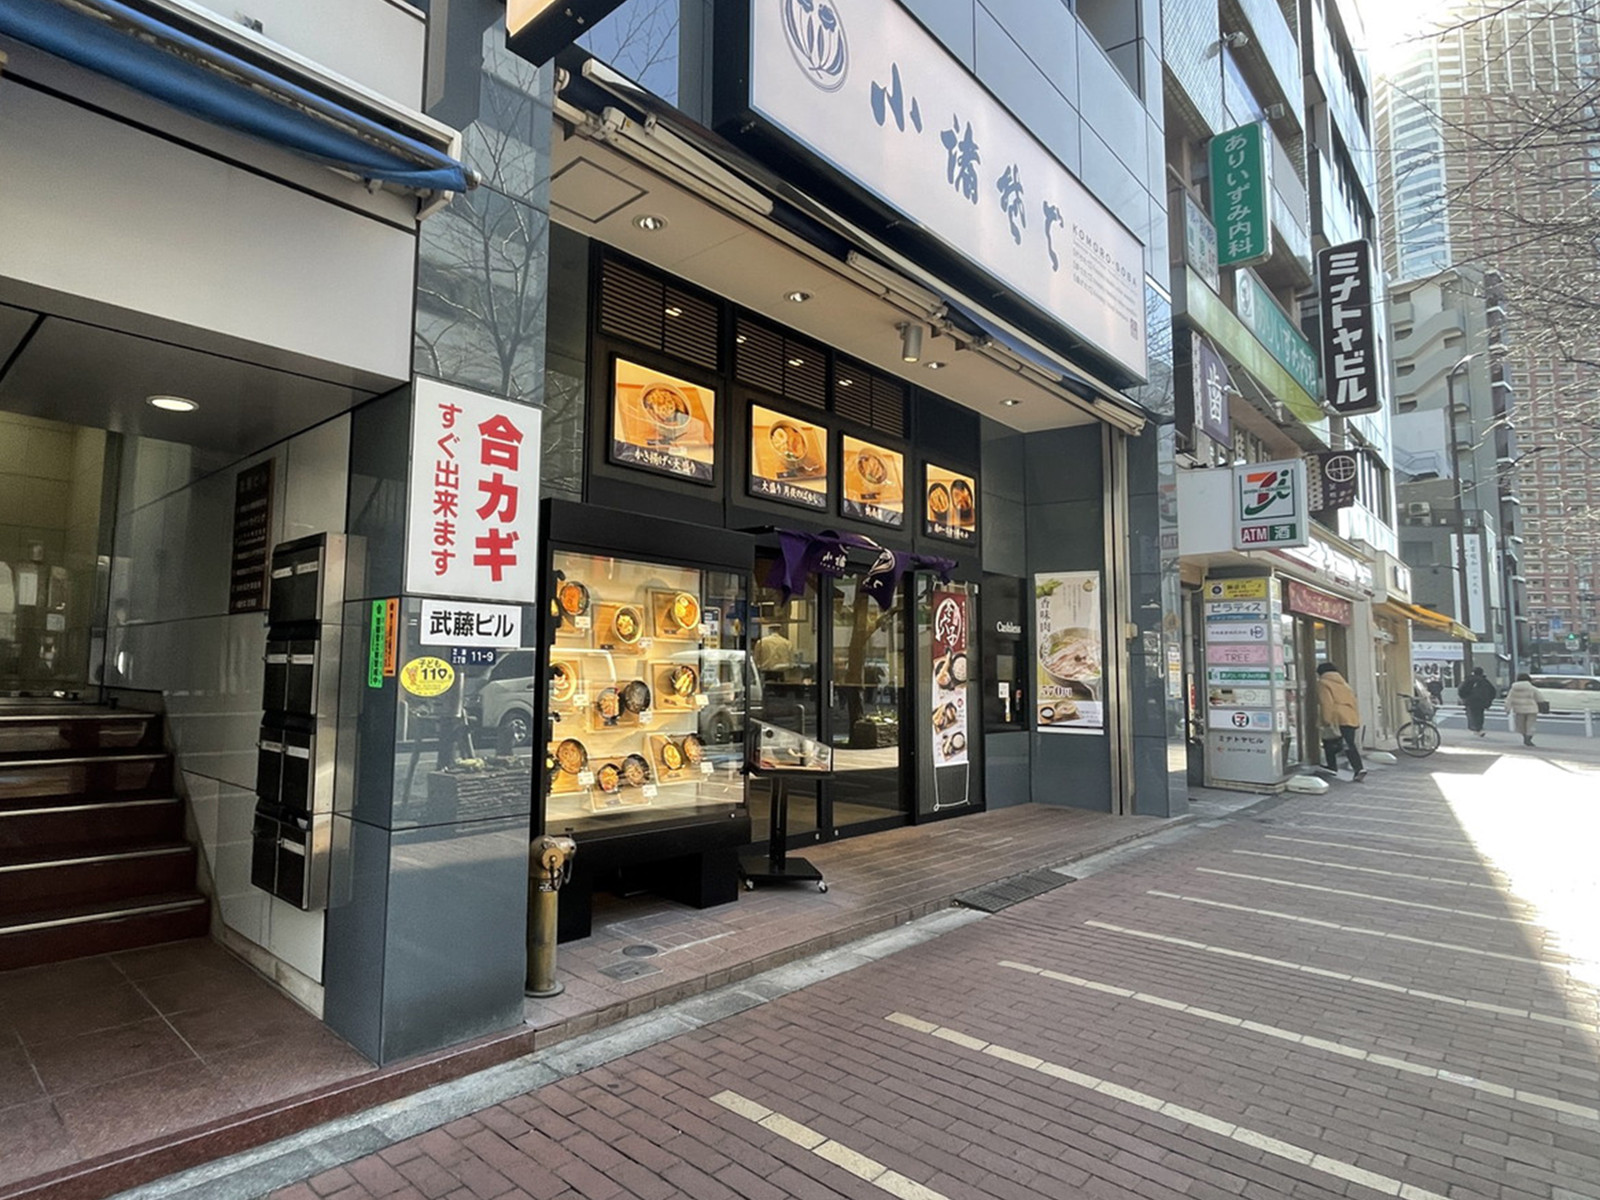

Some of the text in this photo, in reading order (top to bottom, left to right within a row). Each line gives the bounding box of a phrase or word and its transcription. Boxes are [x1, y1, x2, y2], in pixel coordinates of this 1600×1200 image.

[1224, 134, 1253, 258] ありいずみ内科
[1328, 251, 1368, 406] ミナトヤビル
[430, 402, 463, 576] すぐ出来ます
[473, 413, 523, 582] 合カギ
[1242, 527, 1268, 543] ATM
[1274, 526, 1291, 540] 酒
[430, 610, 514, 638] 武藤ビル
[418, 659, 442, 668] 子ども
[471, 651, 494, 662] 11-9
[1224, 653, 1250, 662] TREE
